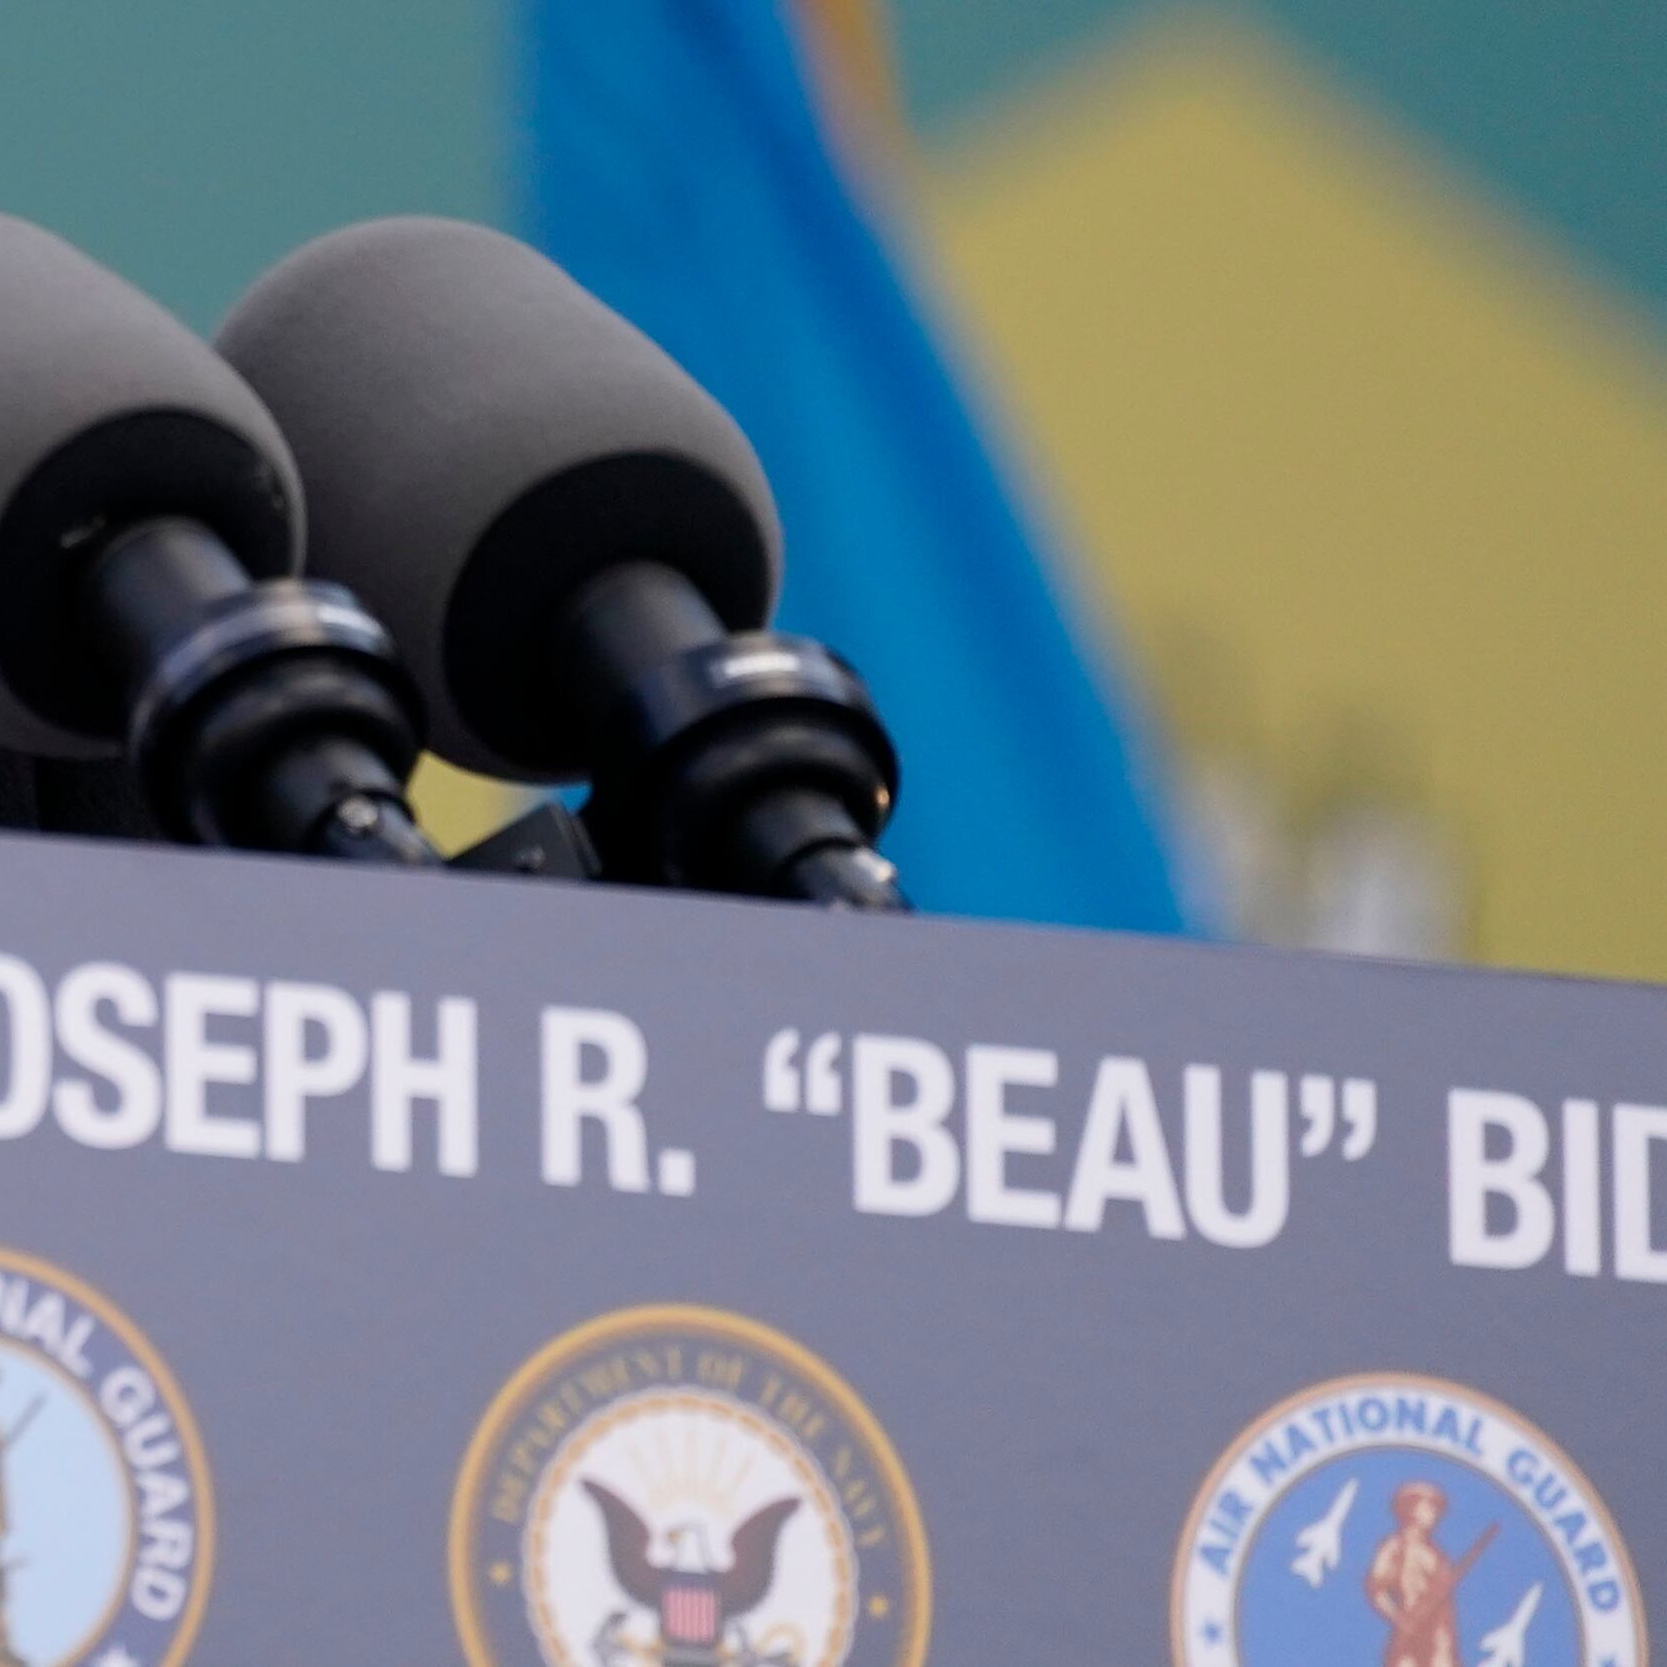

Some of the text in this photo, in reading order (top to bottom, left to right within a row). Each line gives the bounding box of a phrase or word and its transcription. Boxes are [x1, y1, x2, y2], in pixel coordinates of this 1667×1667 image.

[540, 1006, 695, 1196] R.
[763, 1030, 1377, 1248] “BEAU”
[99, 1365, 194, 1621] GUARD
[1200, 1395, 1622, 1614] AIR NATIONAL GUARD
